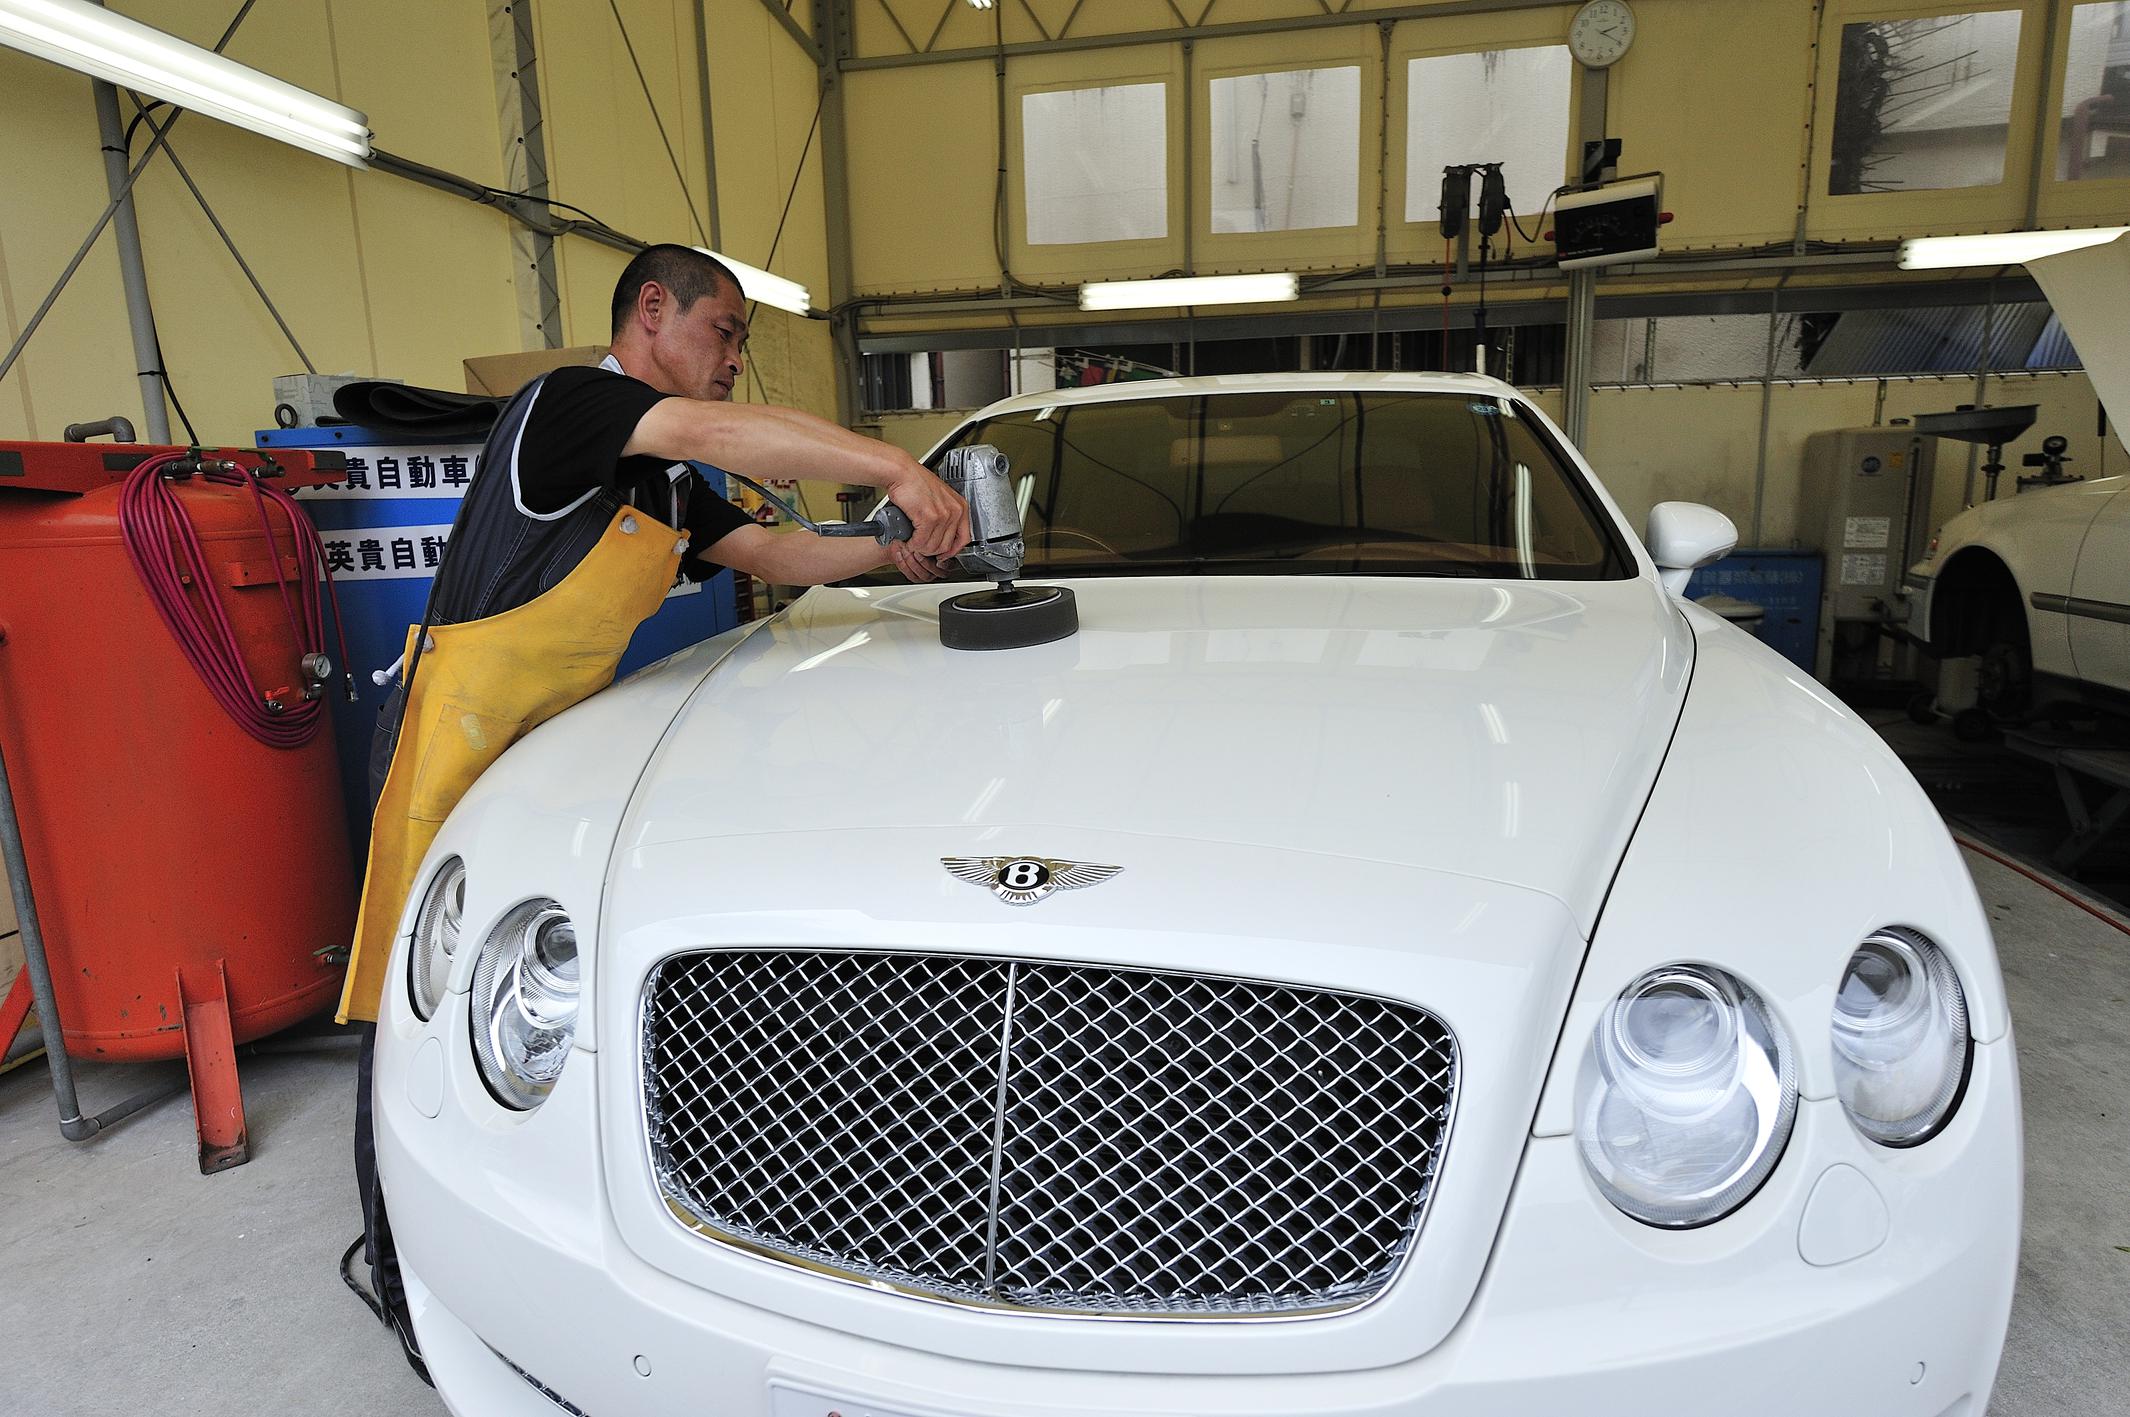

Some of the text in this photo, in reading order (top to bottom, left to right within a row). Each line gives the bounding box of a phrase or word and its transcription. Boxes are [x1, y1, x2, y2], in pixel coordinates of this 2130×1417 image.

[313, 455, 471, 491] 貴自動車
[325, 536, 447, 572] 英貴自動
[1005, 861, 1040, 888] B
